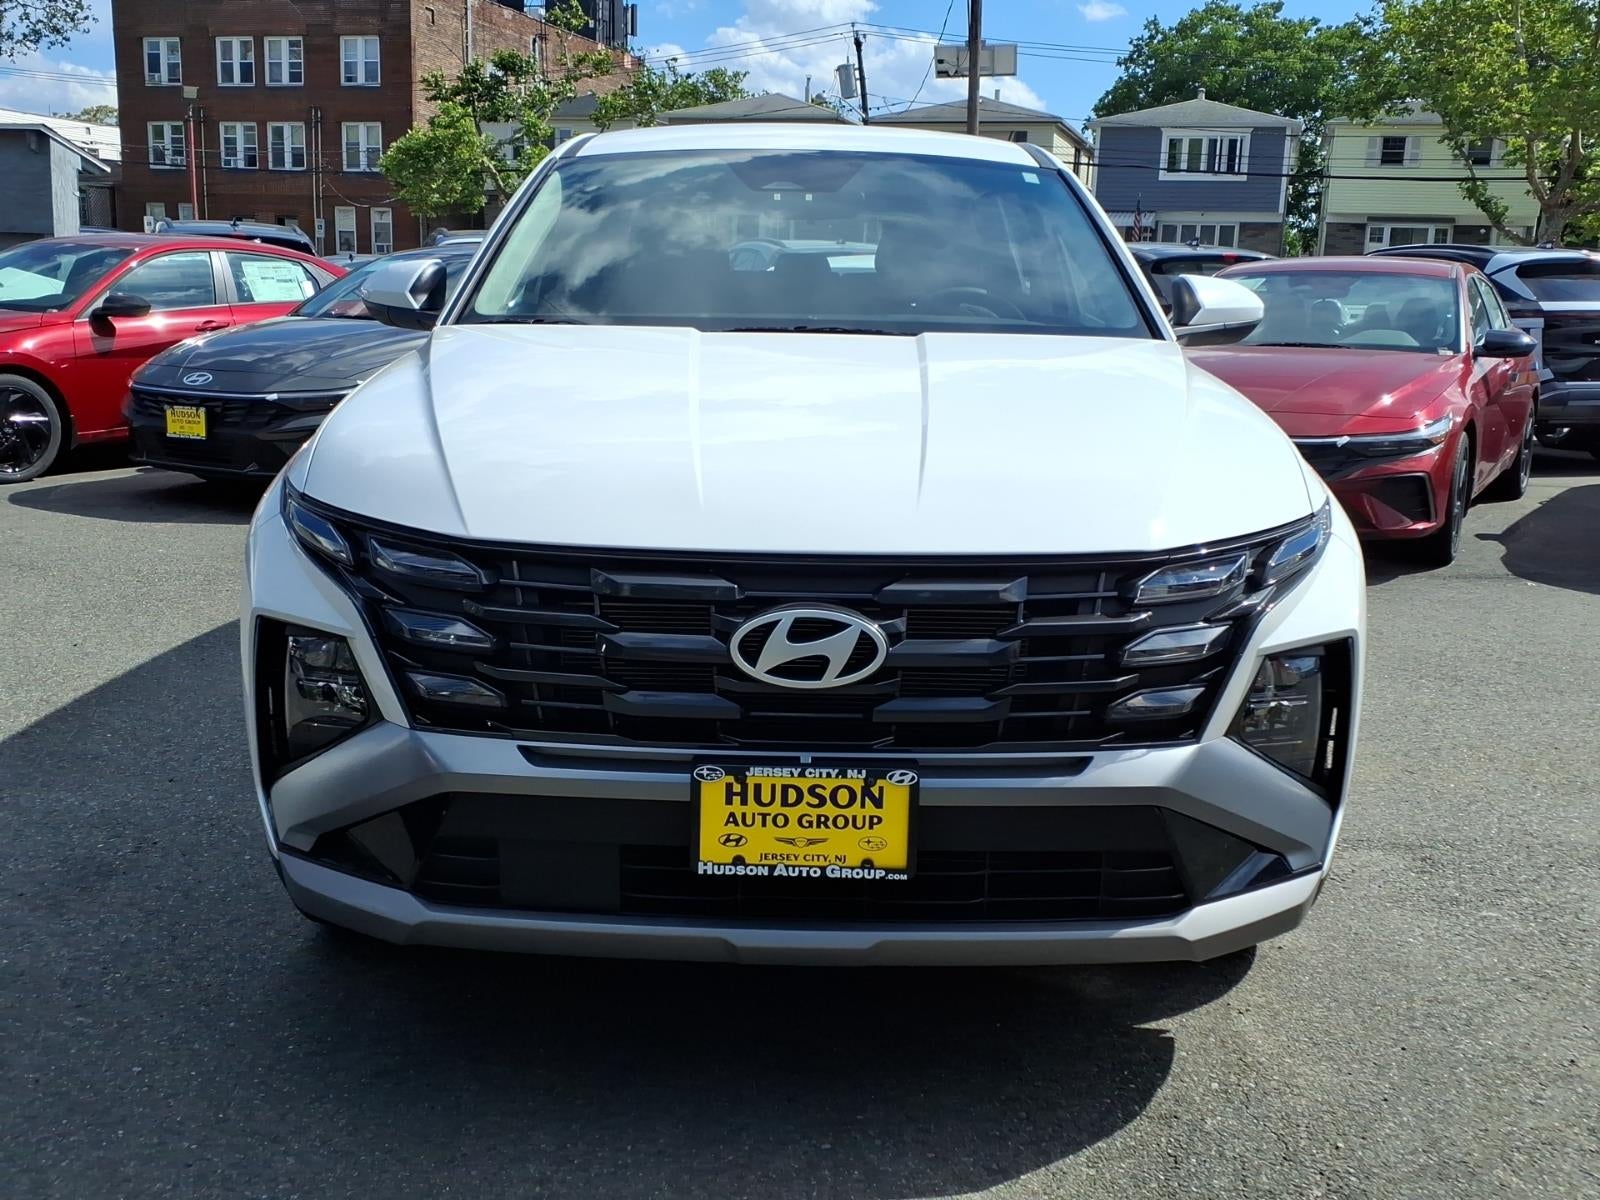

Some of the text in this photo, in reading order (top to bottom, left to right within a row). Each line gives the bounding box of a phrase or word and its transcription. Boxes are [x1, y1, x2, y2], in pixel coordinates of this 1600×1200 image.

[170, 409, 201, 419] HUDSON
[745, 767, 801, 778] JERSEY
[847, 769, 866, 779] NJ
[724, 782, 884, 809] HUDSON
[724, 812, 883, 830] AUTO GROUP
[759, 853, 799, 862] JERSEY
[834, 855, 847, 864] NJ
